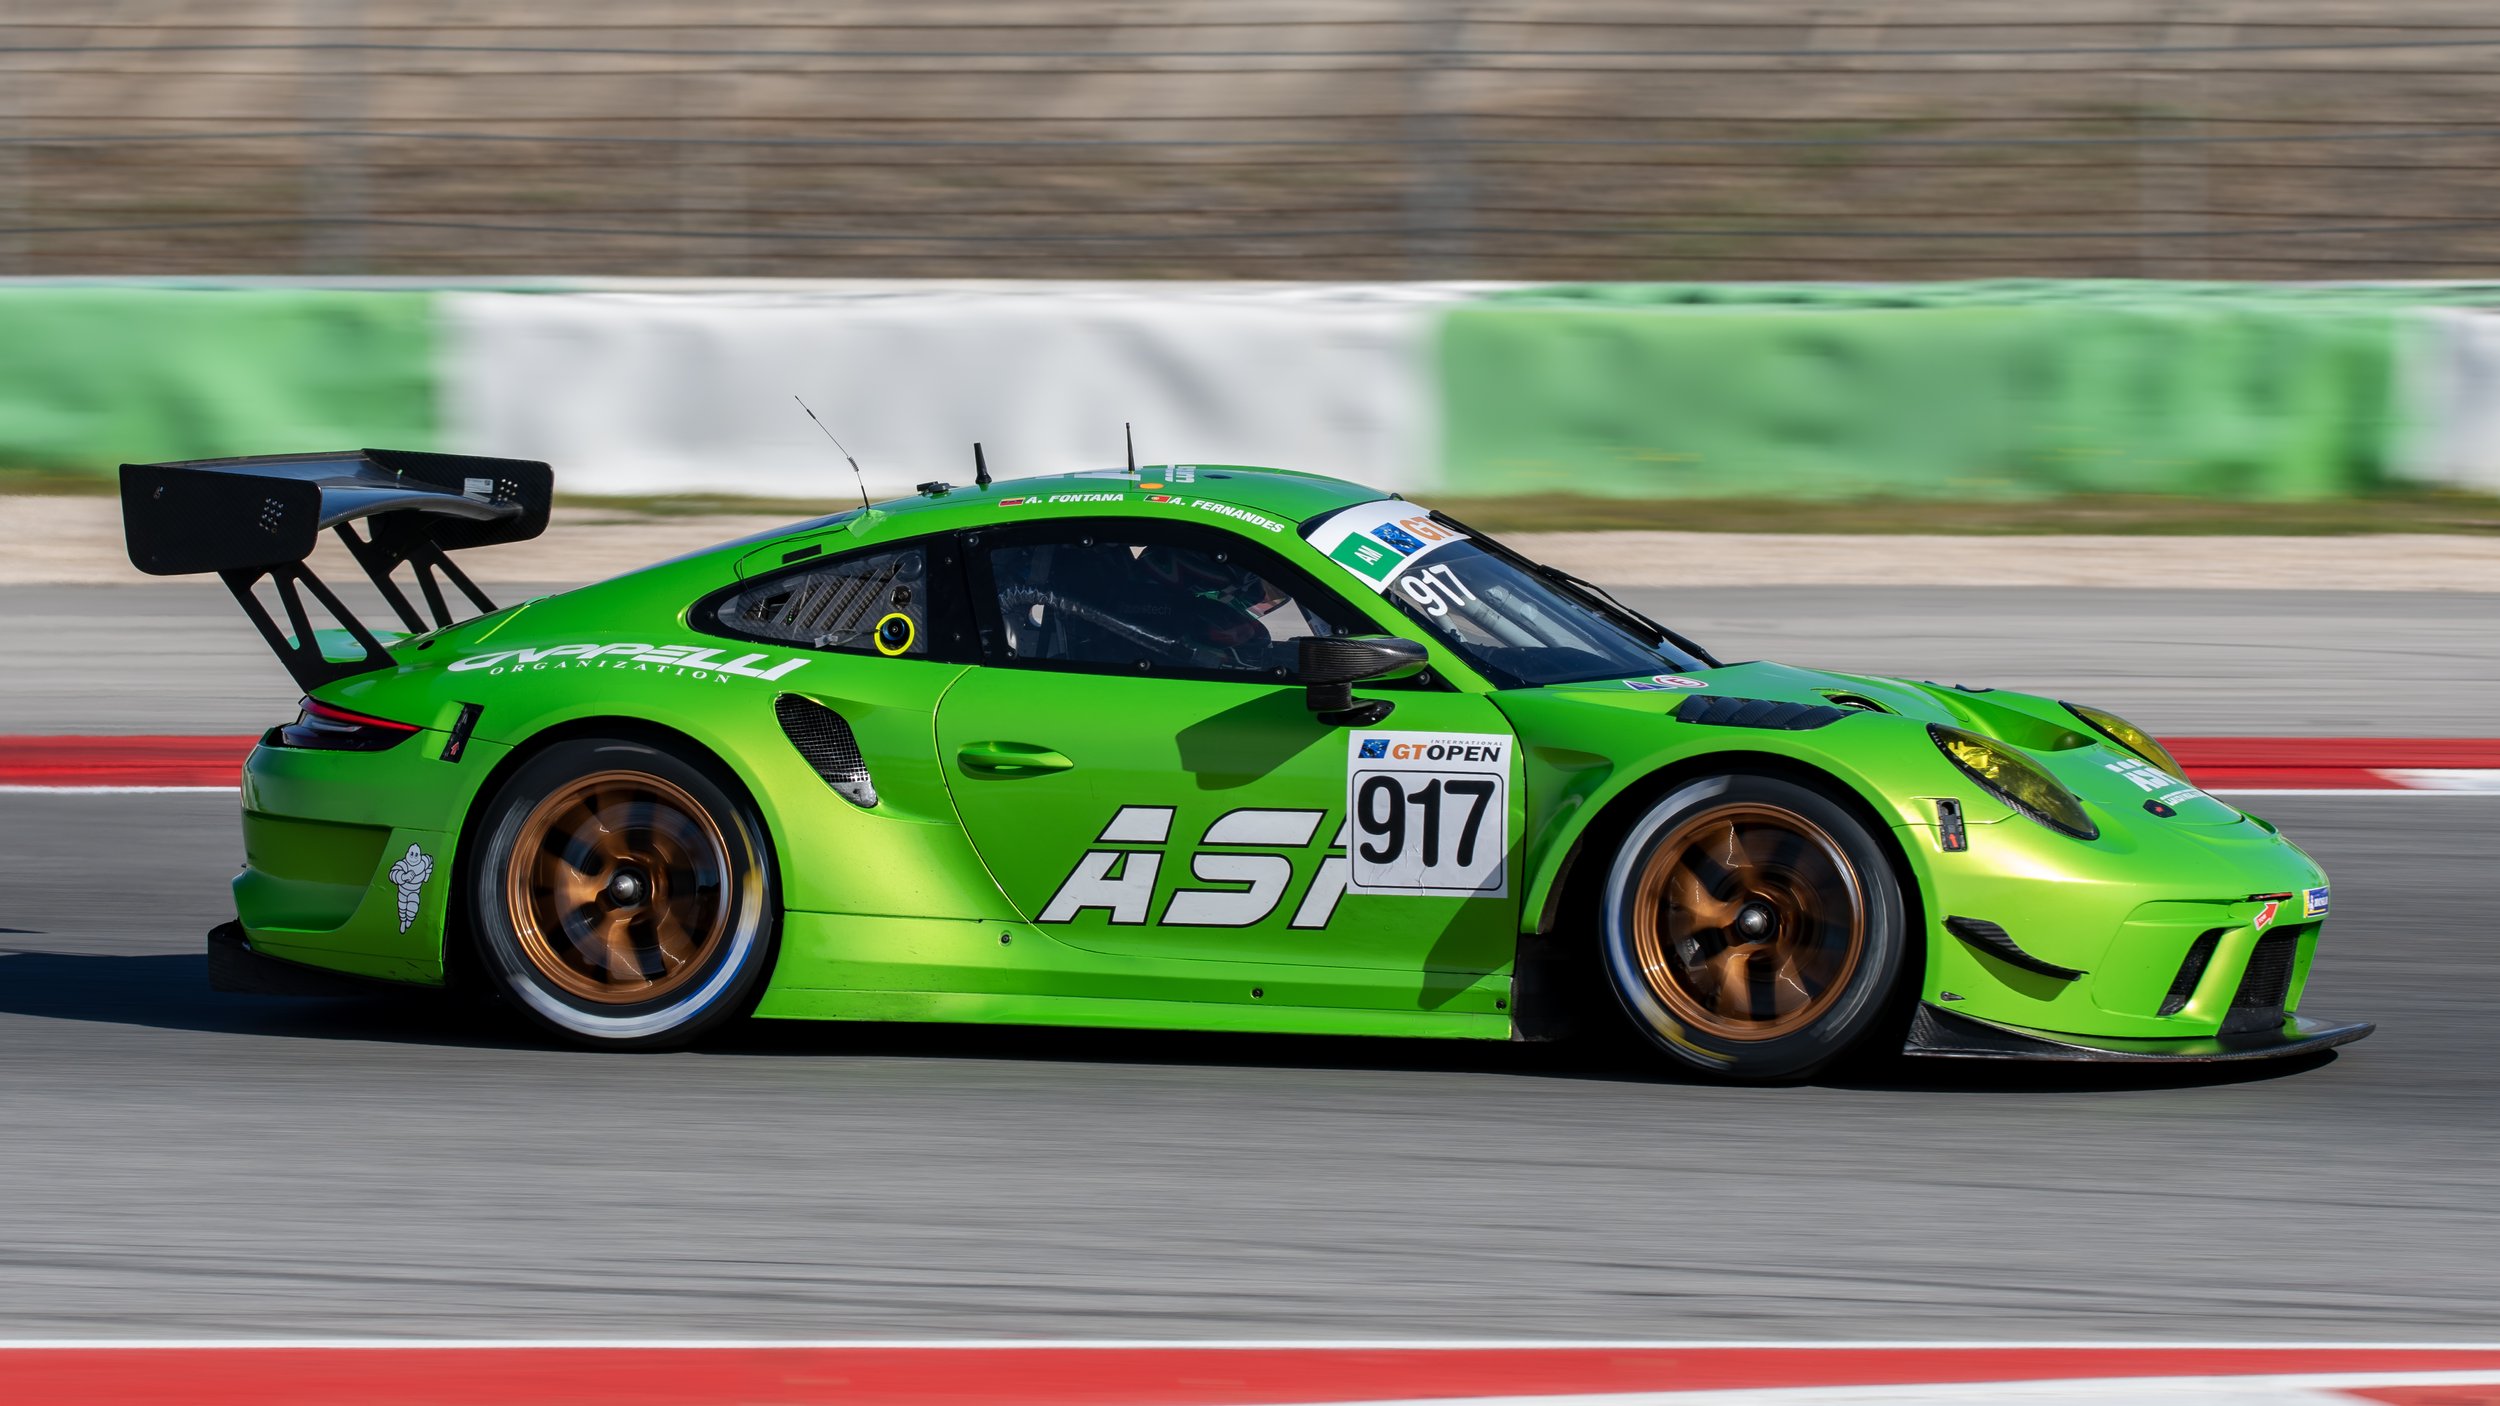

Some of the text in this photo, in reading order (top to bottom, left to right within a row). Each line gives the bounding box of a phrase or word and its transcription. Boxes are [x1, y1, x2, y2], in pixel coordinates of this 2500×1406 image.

[1025, 493, 1124, 504] A. FONTANA
[1168, 497, 1285, 534] A. FERNANDES
[1353, 545, 1384, 566] AM
[1400, 563, 1477, 617] 917
[447, 642, 813, 681] CAPPELLI
[489, 659, 732, 684] ORGANIZATION
[1357, 775, 1495, 868] 917
